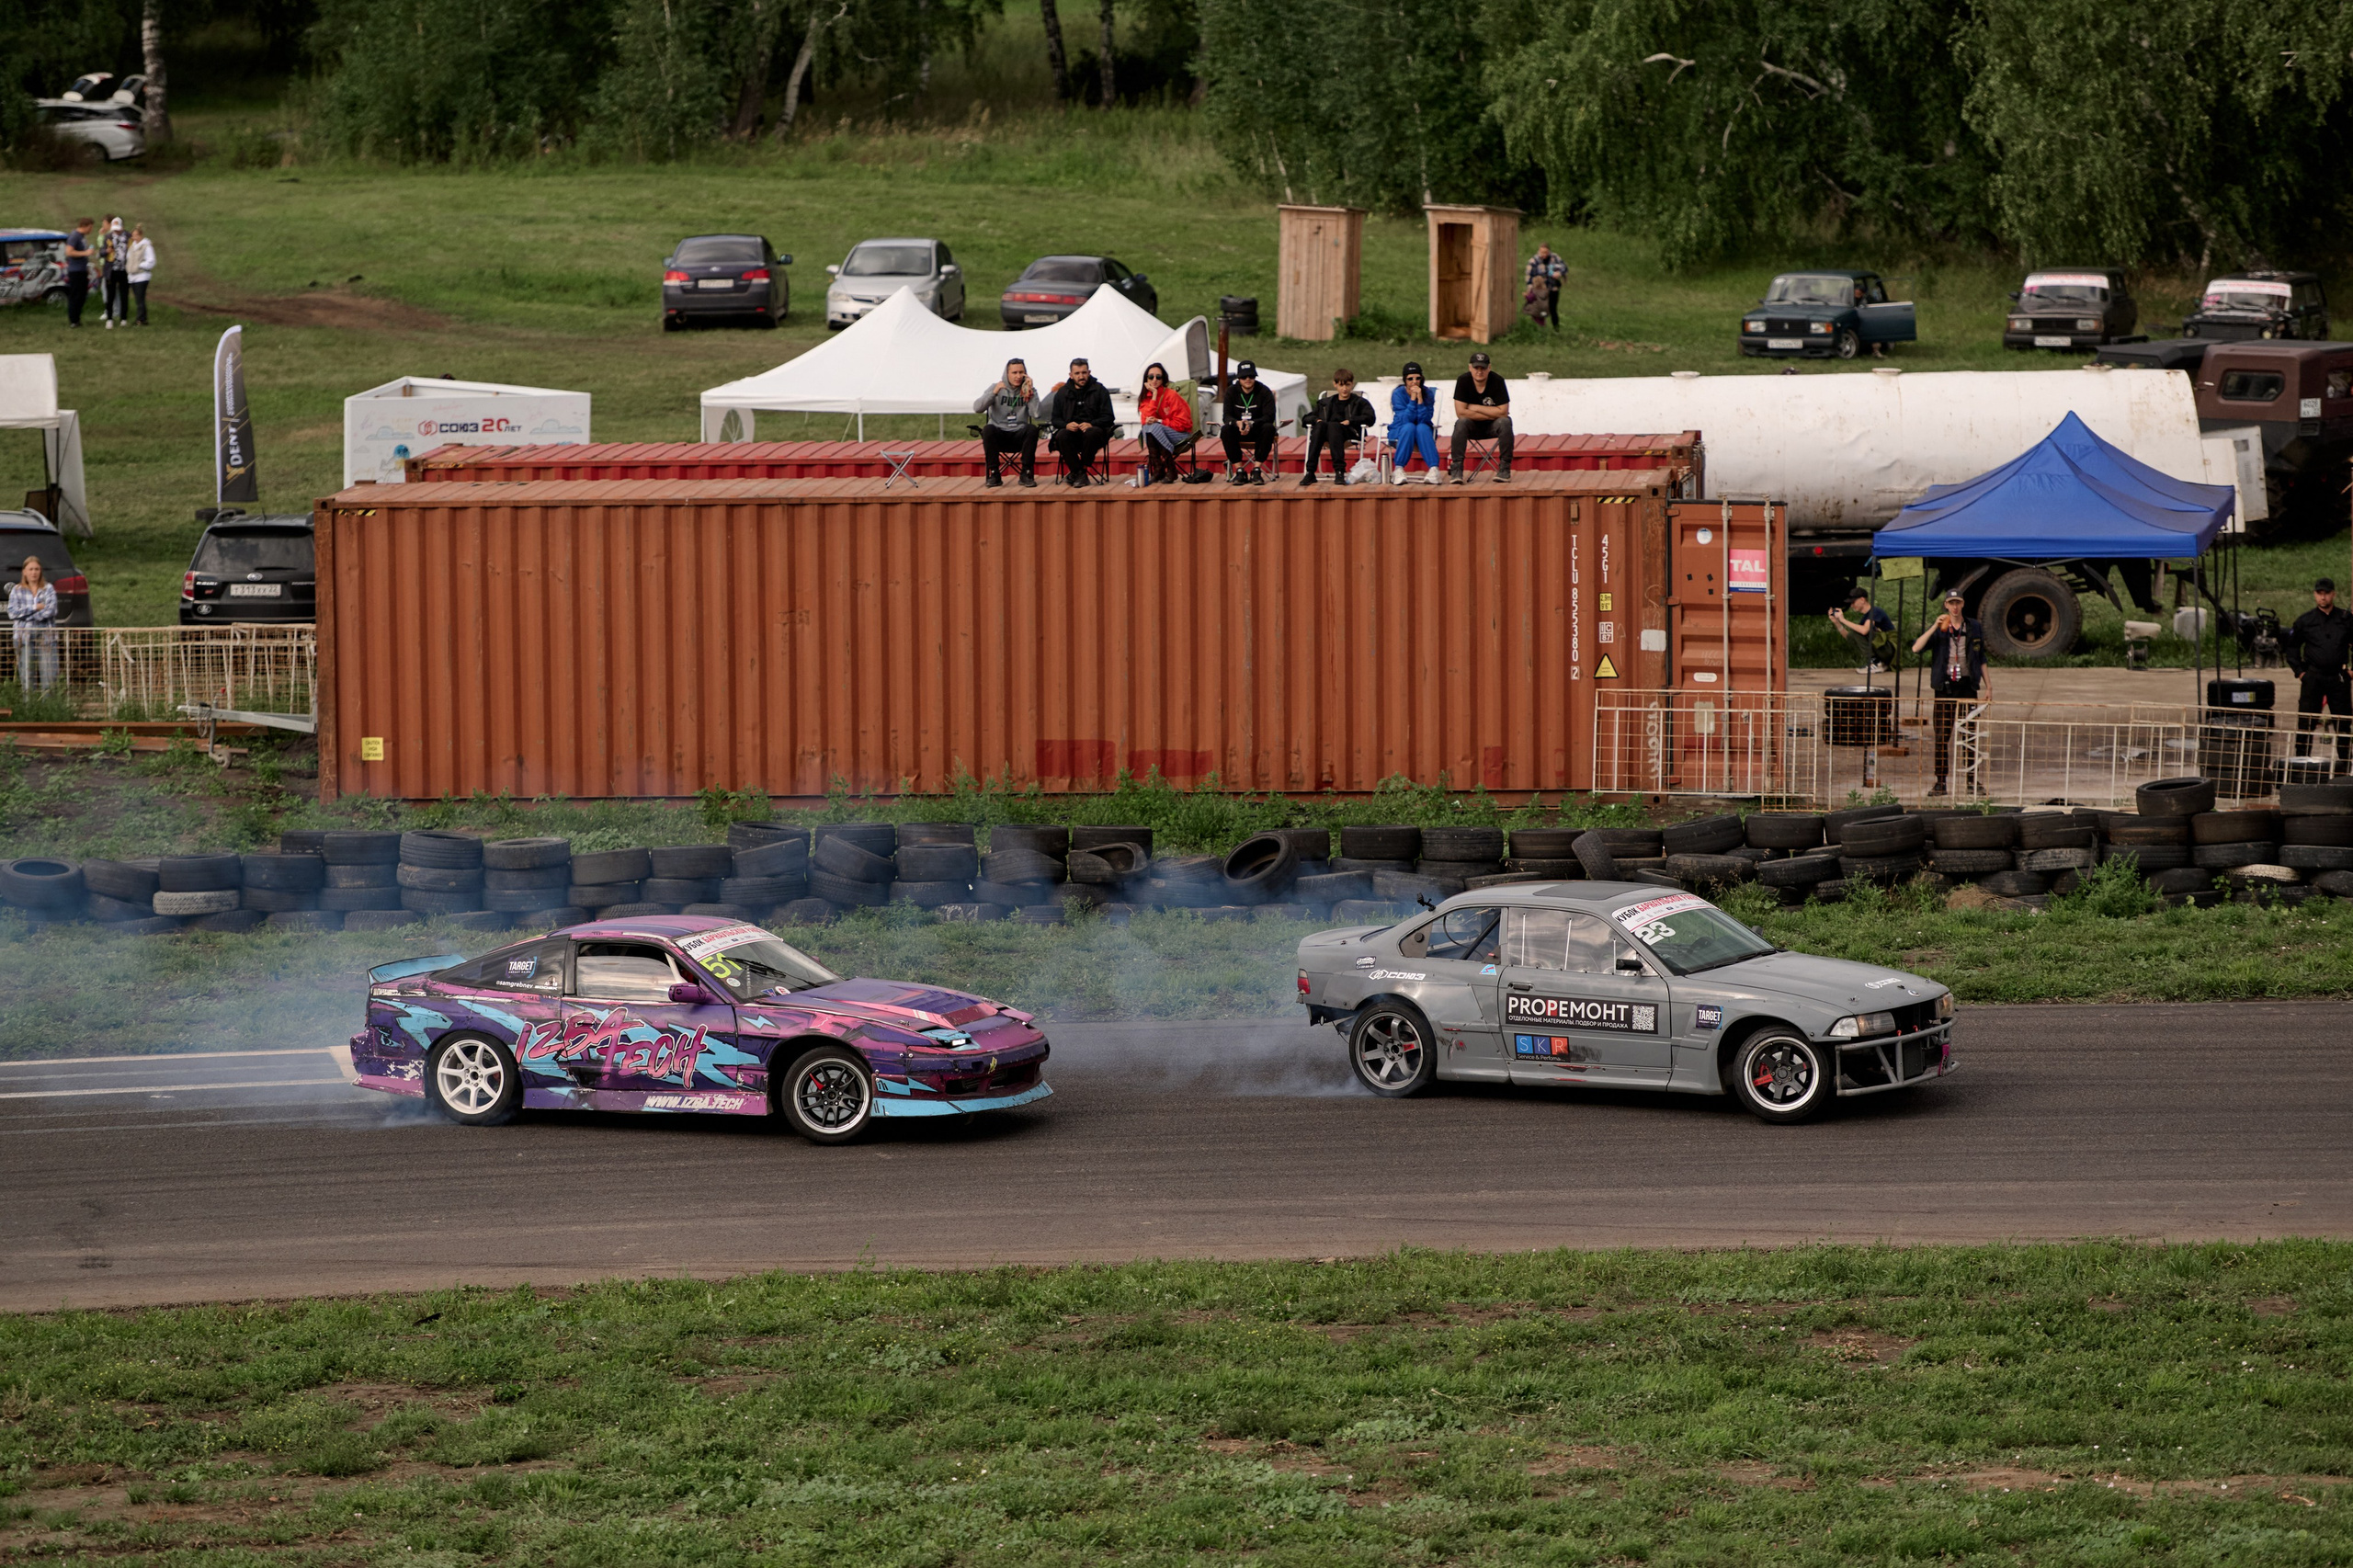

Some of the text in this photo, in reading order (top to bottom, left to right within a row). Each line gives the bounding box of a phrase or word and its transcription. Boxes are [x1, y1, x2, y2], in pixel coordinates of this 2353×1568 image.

[439, 422, 479, 433] СОЮЗ
[1730, 559, 1766, 572] TAL
[1573, 667, 1578, 679] 2
[1615, 907, 1640, 923] КУБОК
[1634, 921, 1676, 946] 23
[681, 938, 705, 952] КУБОК
[509, 961, 535, 971] TARGET
[699, 952, 743, 979] 51
[1387, 971, 1426, 981] СОЮЗ
[1508, 1015, 1542, 1023] ОТДЕЛОЧНЫЕ
[1699, 1010, 1722, 1021] TARGET
[515, 1007, 644, 1063] IZBA
[1519, 1037, 1565, 1052] SKR
[597, 1024, 707, 1090] TECH
[643, 1095, 745, 1110] WWW.IZBA.TECH
